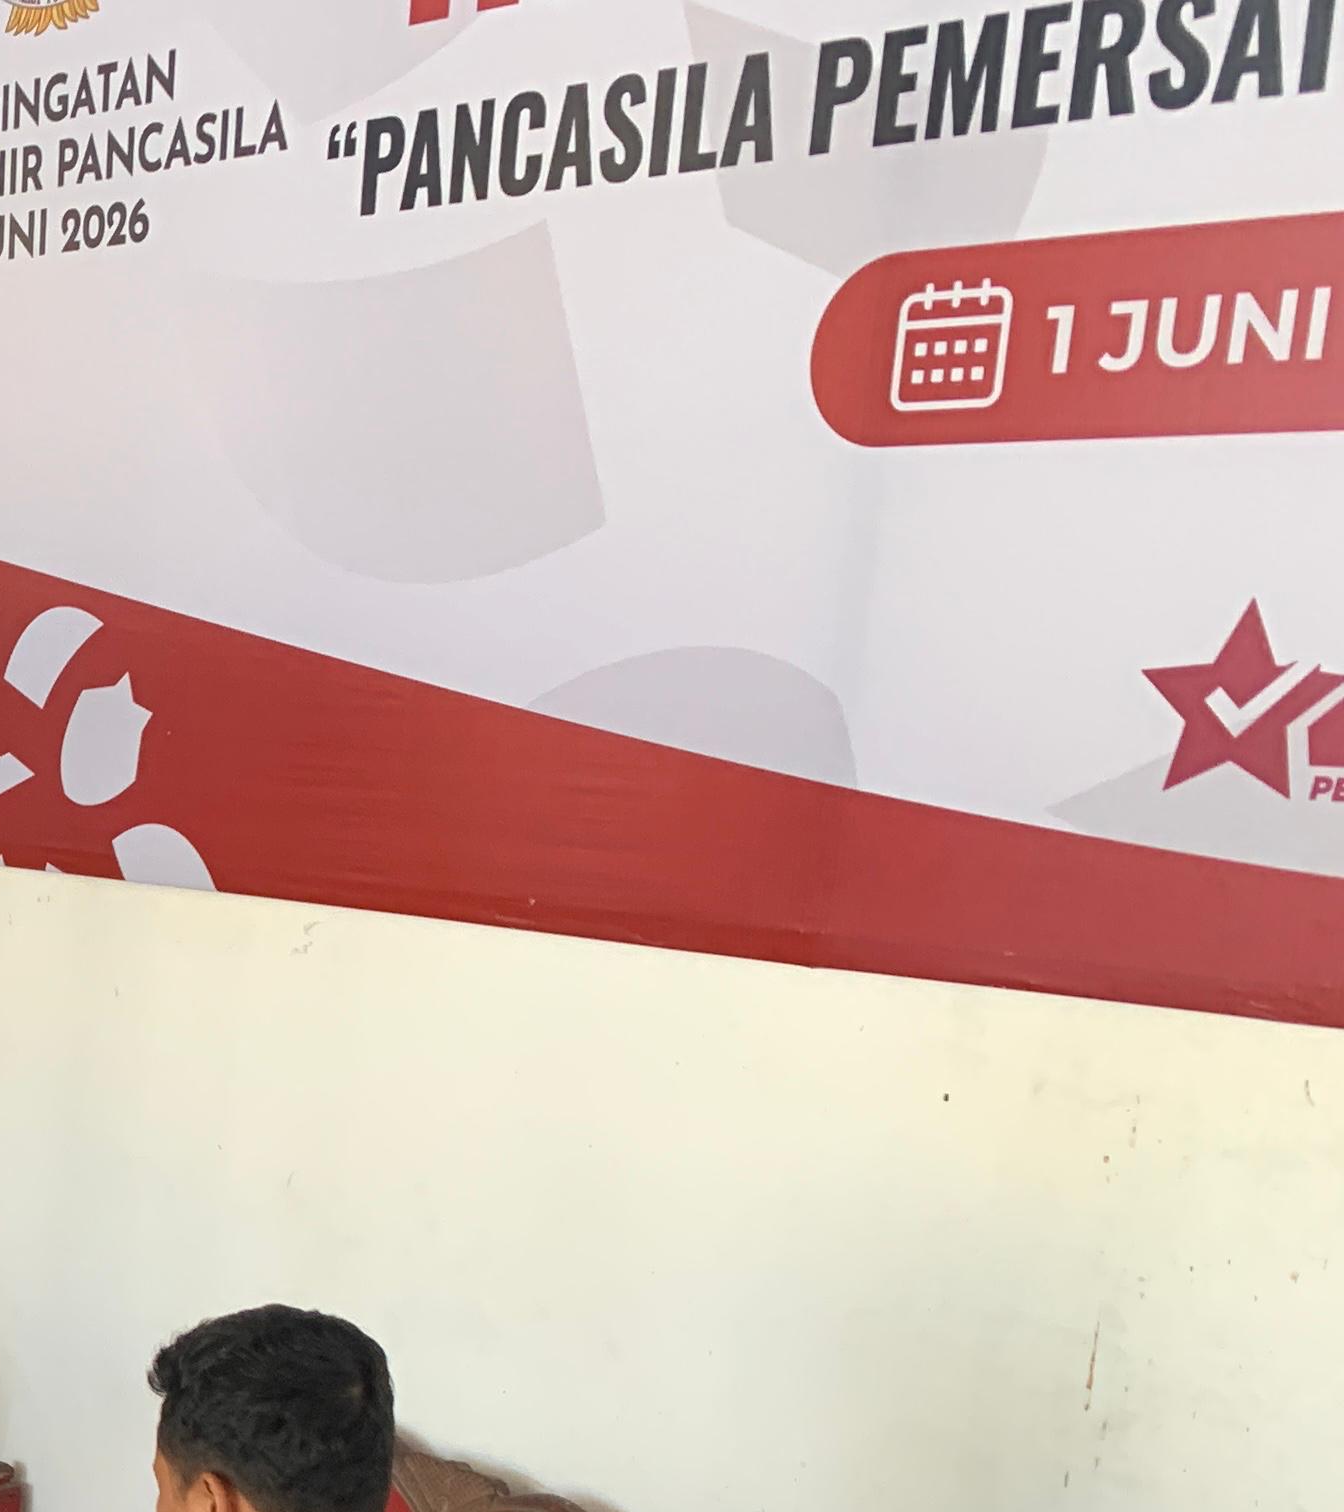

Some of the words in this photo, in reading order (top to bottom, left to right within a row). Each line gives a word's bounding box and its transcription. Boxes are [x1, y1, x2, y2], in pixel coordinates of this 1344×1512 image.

[56, 99, 289, 187] PANCASILA
[61, 197, 150, 253] 2026
[1046, 304, 1076, 375] 1
[1097, 285, 1333, 373] JUNI
